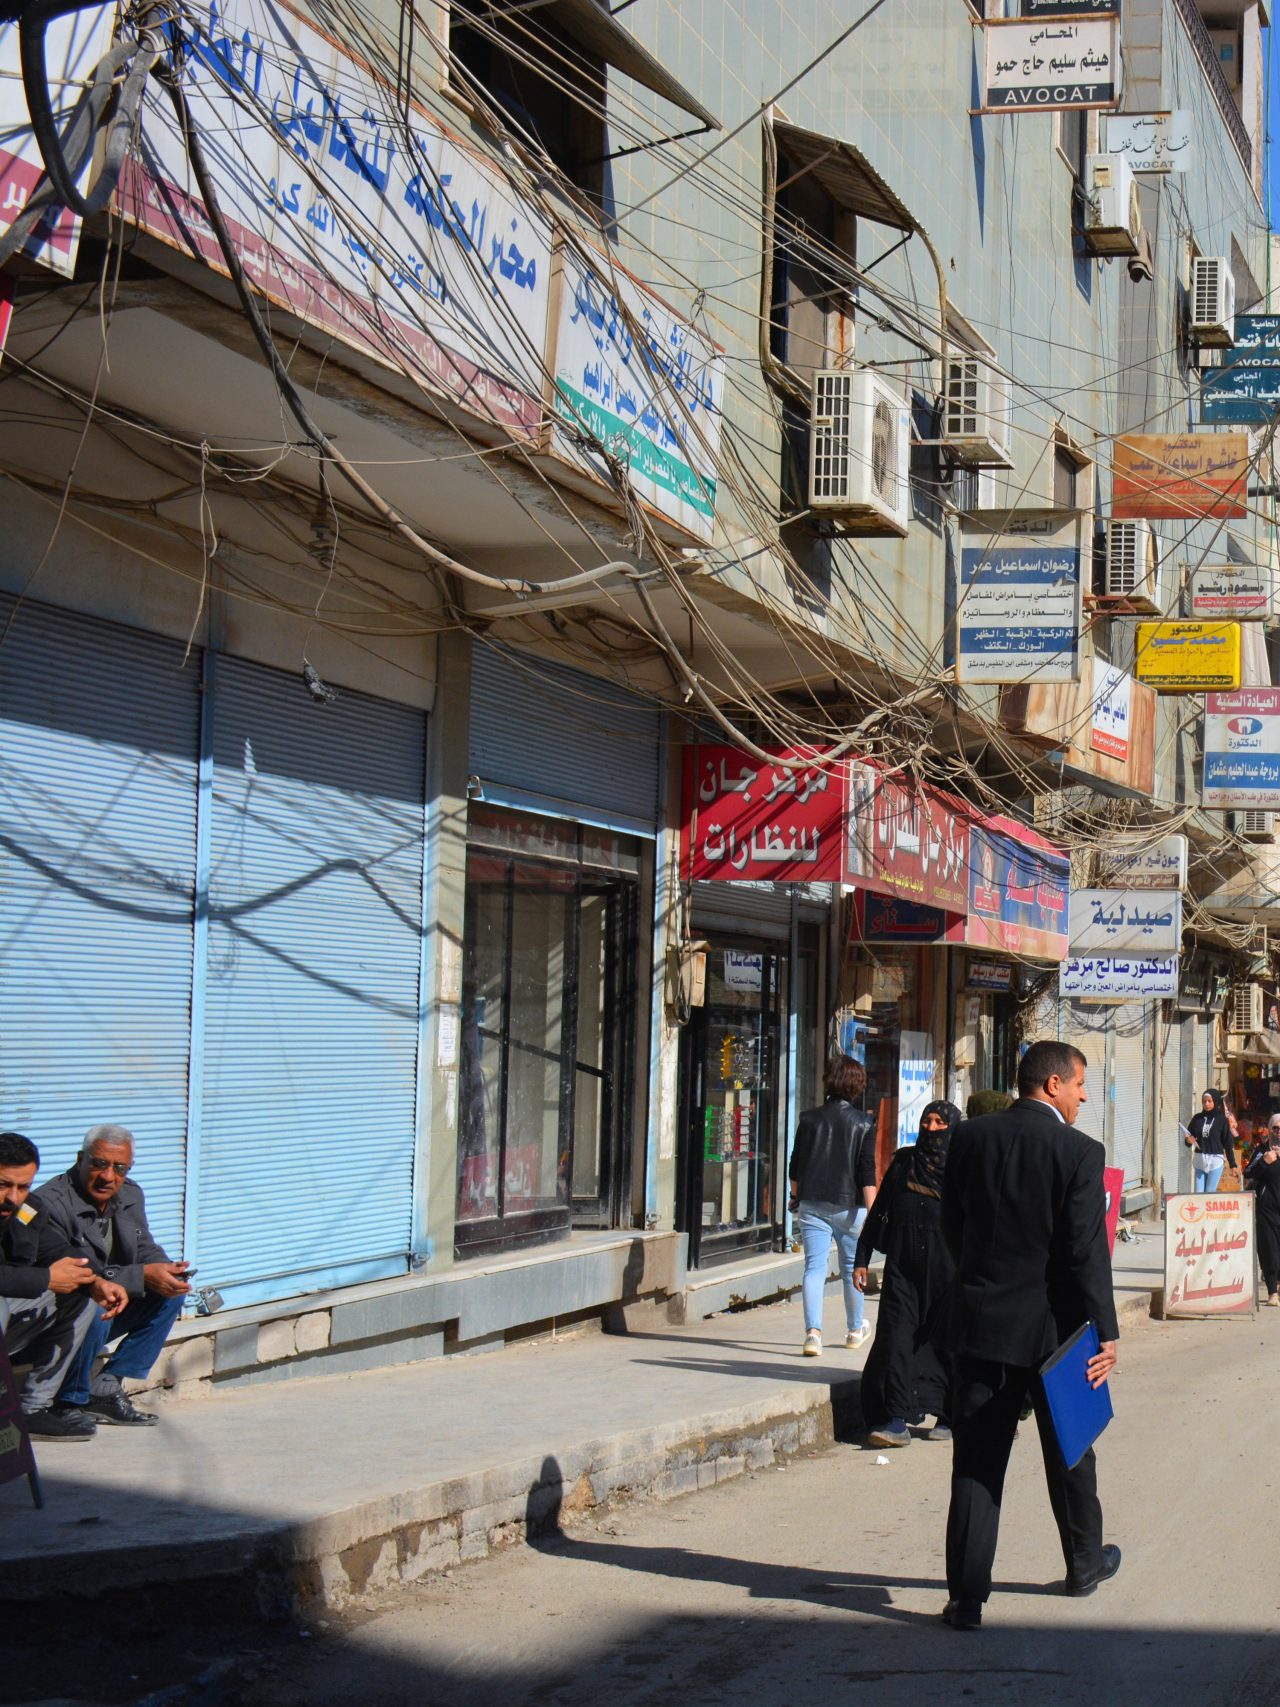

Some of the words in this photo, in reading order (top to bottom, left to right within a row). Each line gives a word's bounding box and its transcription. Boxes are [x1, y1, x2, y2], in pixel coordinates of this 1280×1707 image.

[1029, 26, 1078, 46] المحامي
[994, 60, 1018, 76] حمو
[1022, 55, 1045, 76] حاج
[1049, 53, 1076, 74] سليم
[1080, 48, 1109, 73] هيثم
[1004, 86, 1098, 104] AVOCAT
[1132, 117, 1167, 129] المحامي
[404, 134, 487, 253] الحكمة
[483, 217, 537, 297] مخبر
[1251, 319, 1279, 330] المحامية
[1227, 333, 1261, 351] فتح
[995, 559, 1041, 576] اسماعيل
[1041, 559, 1075, 574] رضوان
[1198, 581, 1226, 596] رشيد
[1170, 625, 1203, 636] الدكتور
[983, 641, 1012, 650] الكتف
[1018, 641, 1045, 651] الورك
[1190, 635, 1227, 645] محمد
[1216, 693, 1246, 711] السنية
[1247, 694, 1278, 711] العيادة
[1228, 738, 1261, 749] الدكتورة
[1208, 760, 1227, 780] عثمان
[699, 757, 758, 802] جان
[762, 756, 828, 803] مركز
[703, 824, 821, 871] للنظارات
[869, 909, 939, 934] سناء
[1091, 900, 1173, 934] صيدلية
[1096, 957, 1130, 979] صالح
[1131, 956, 1177, 979] الدكتور
[1097, 982, 1114, 993] العين
[1205, 1200, 1239, 1211] SANAA
[1175, 1226, 1248, 1266] صيدلية
[1169, 1268, 1244, 1308] سناء
